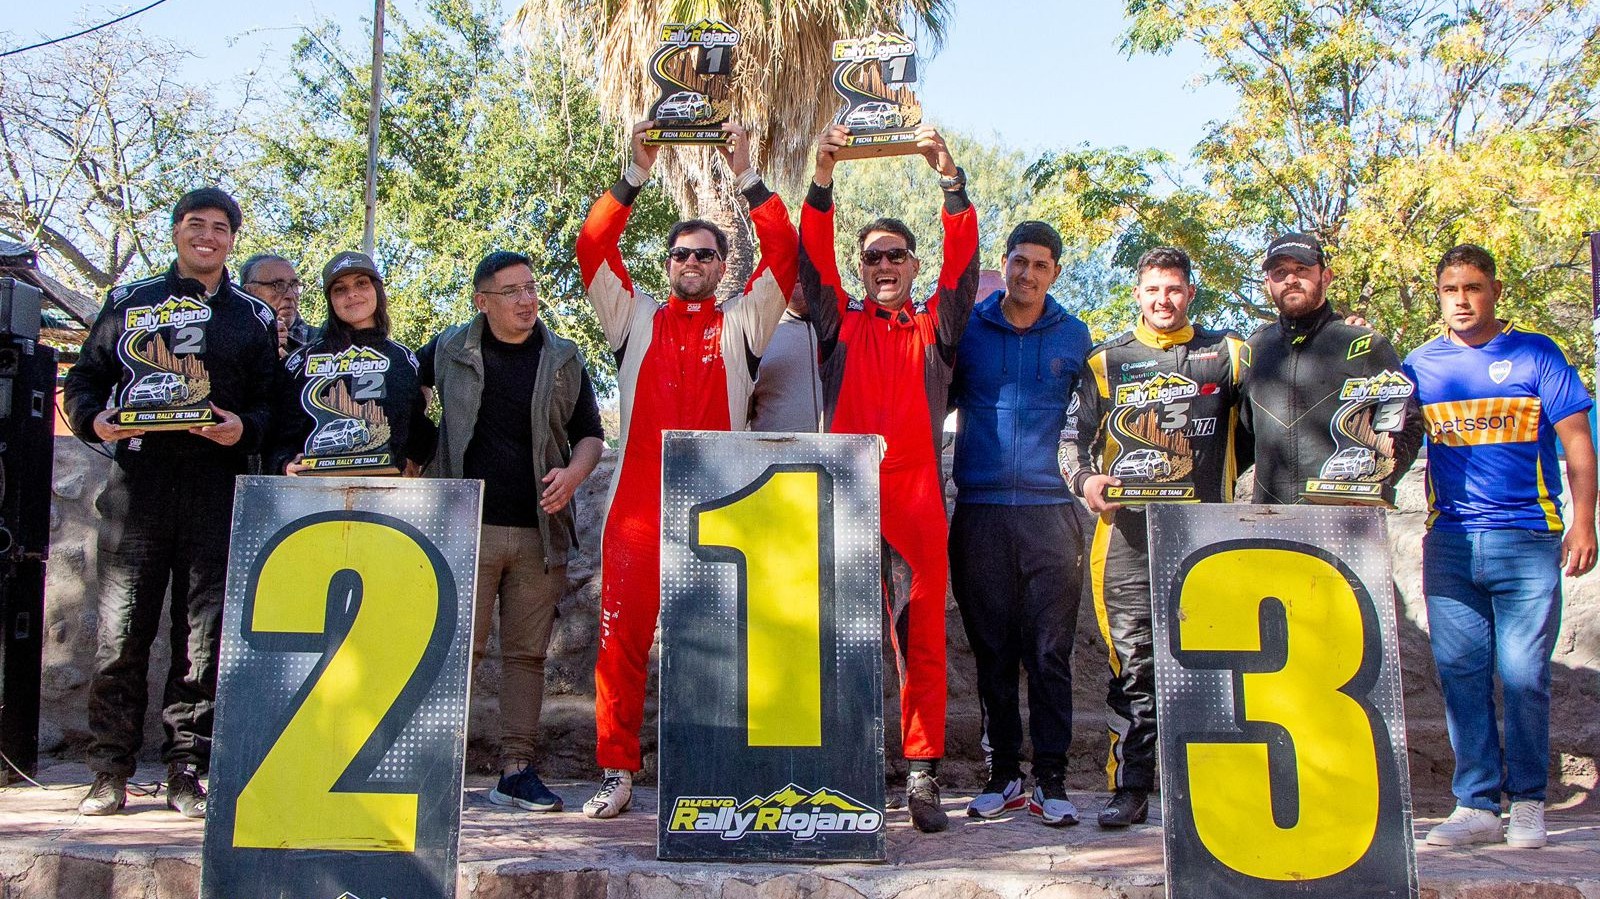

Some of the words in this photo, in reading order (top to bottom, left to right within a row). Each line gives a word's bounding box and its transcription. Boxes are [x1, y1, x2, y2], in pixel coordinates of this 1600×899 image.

[706, 47, 724, 73] 1
[889, 57, 907, 81] 1
[173, 327, 204, 354] 2
[354, 372, 385, 399] 2
[1161, 402, 1191, 429] 3
[1375, 402, 1405, 432] 3
[698, 471, 822, 747] 1
[232, 520, 439, 852] 2
[1180, 549, 1379, 881] 3
[678, 799, 735, 807] nuevo
